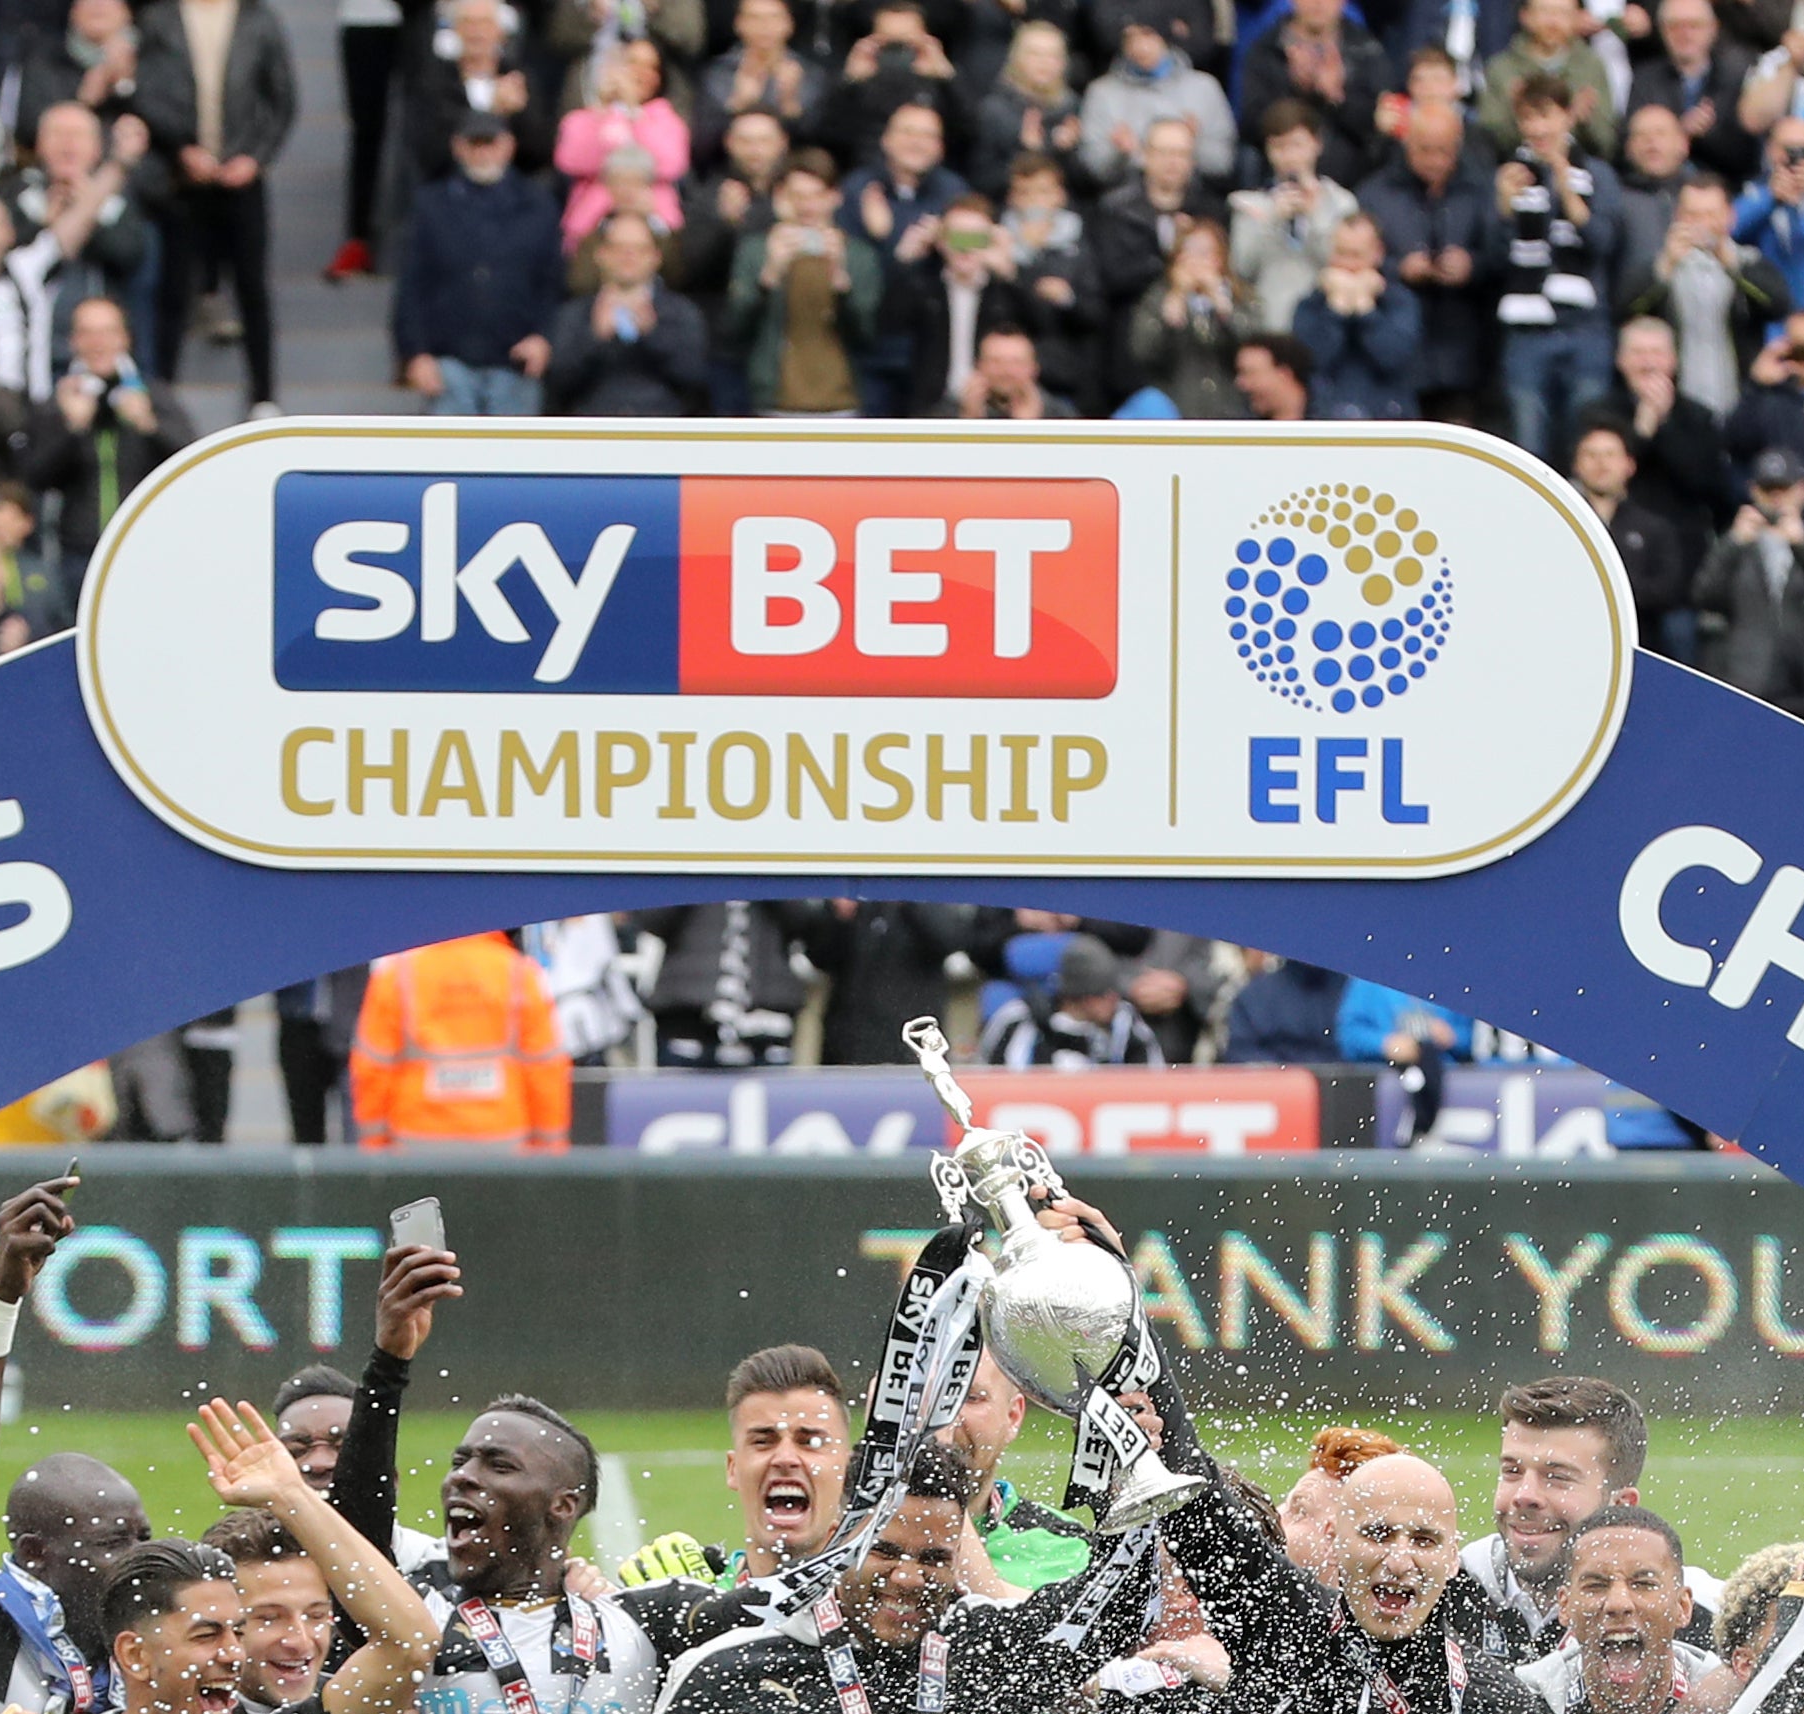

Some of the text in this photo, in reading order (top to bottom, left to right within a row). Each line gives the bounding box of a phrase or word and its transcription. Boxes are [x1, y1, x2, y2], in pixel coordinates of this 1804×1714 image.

[313, 481, 1072, 684] sky BET
[277, 725, 1110, 823] CHAMPIONSHIP
[1247, 737, 1429, 826] EFL
[1102, 1400, 1139, 1452] BET
